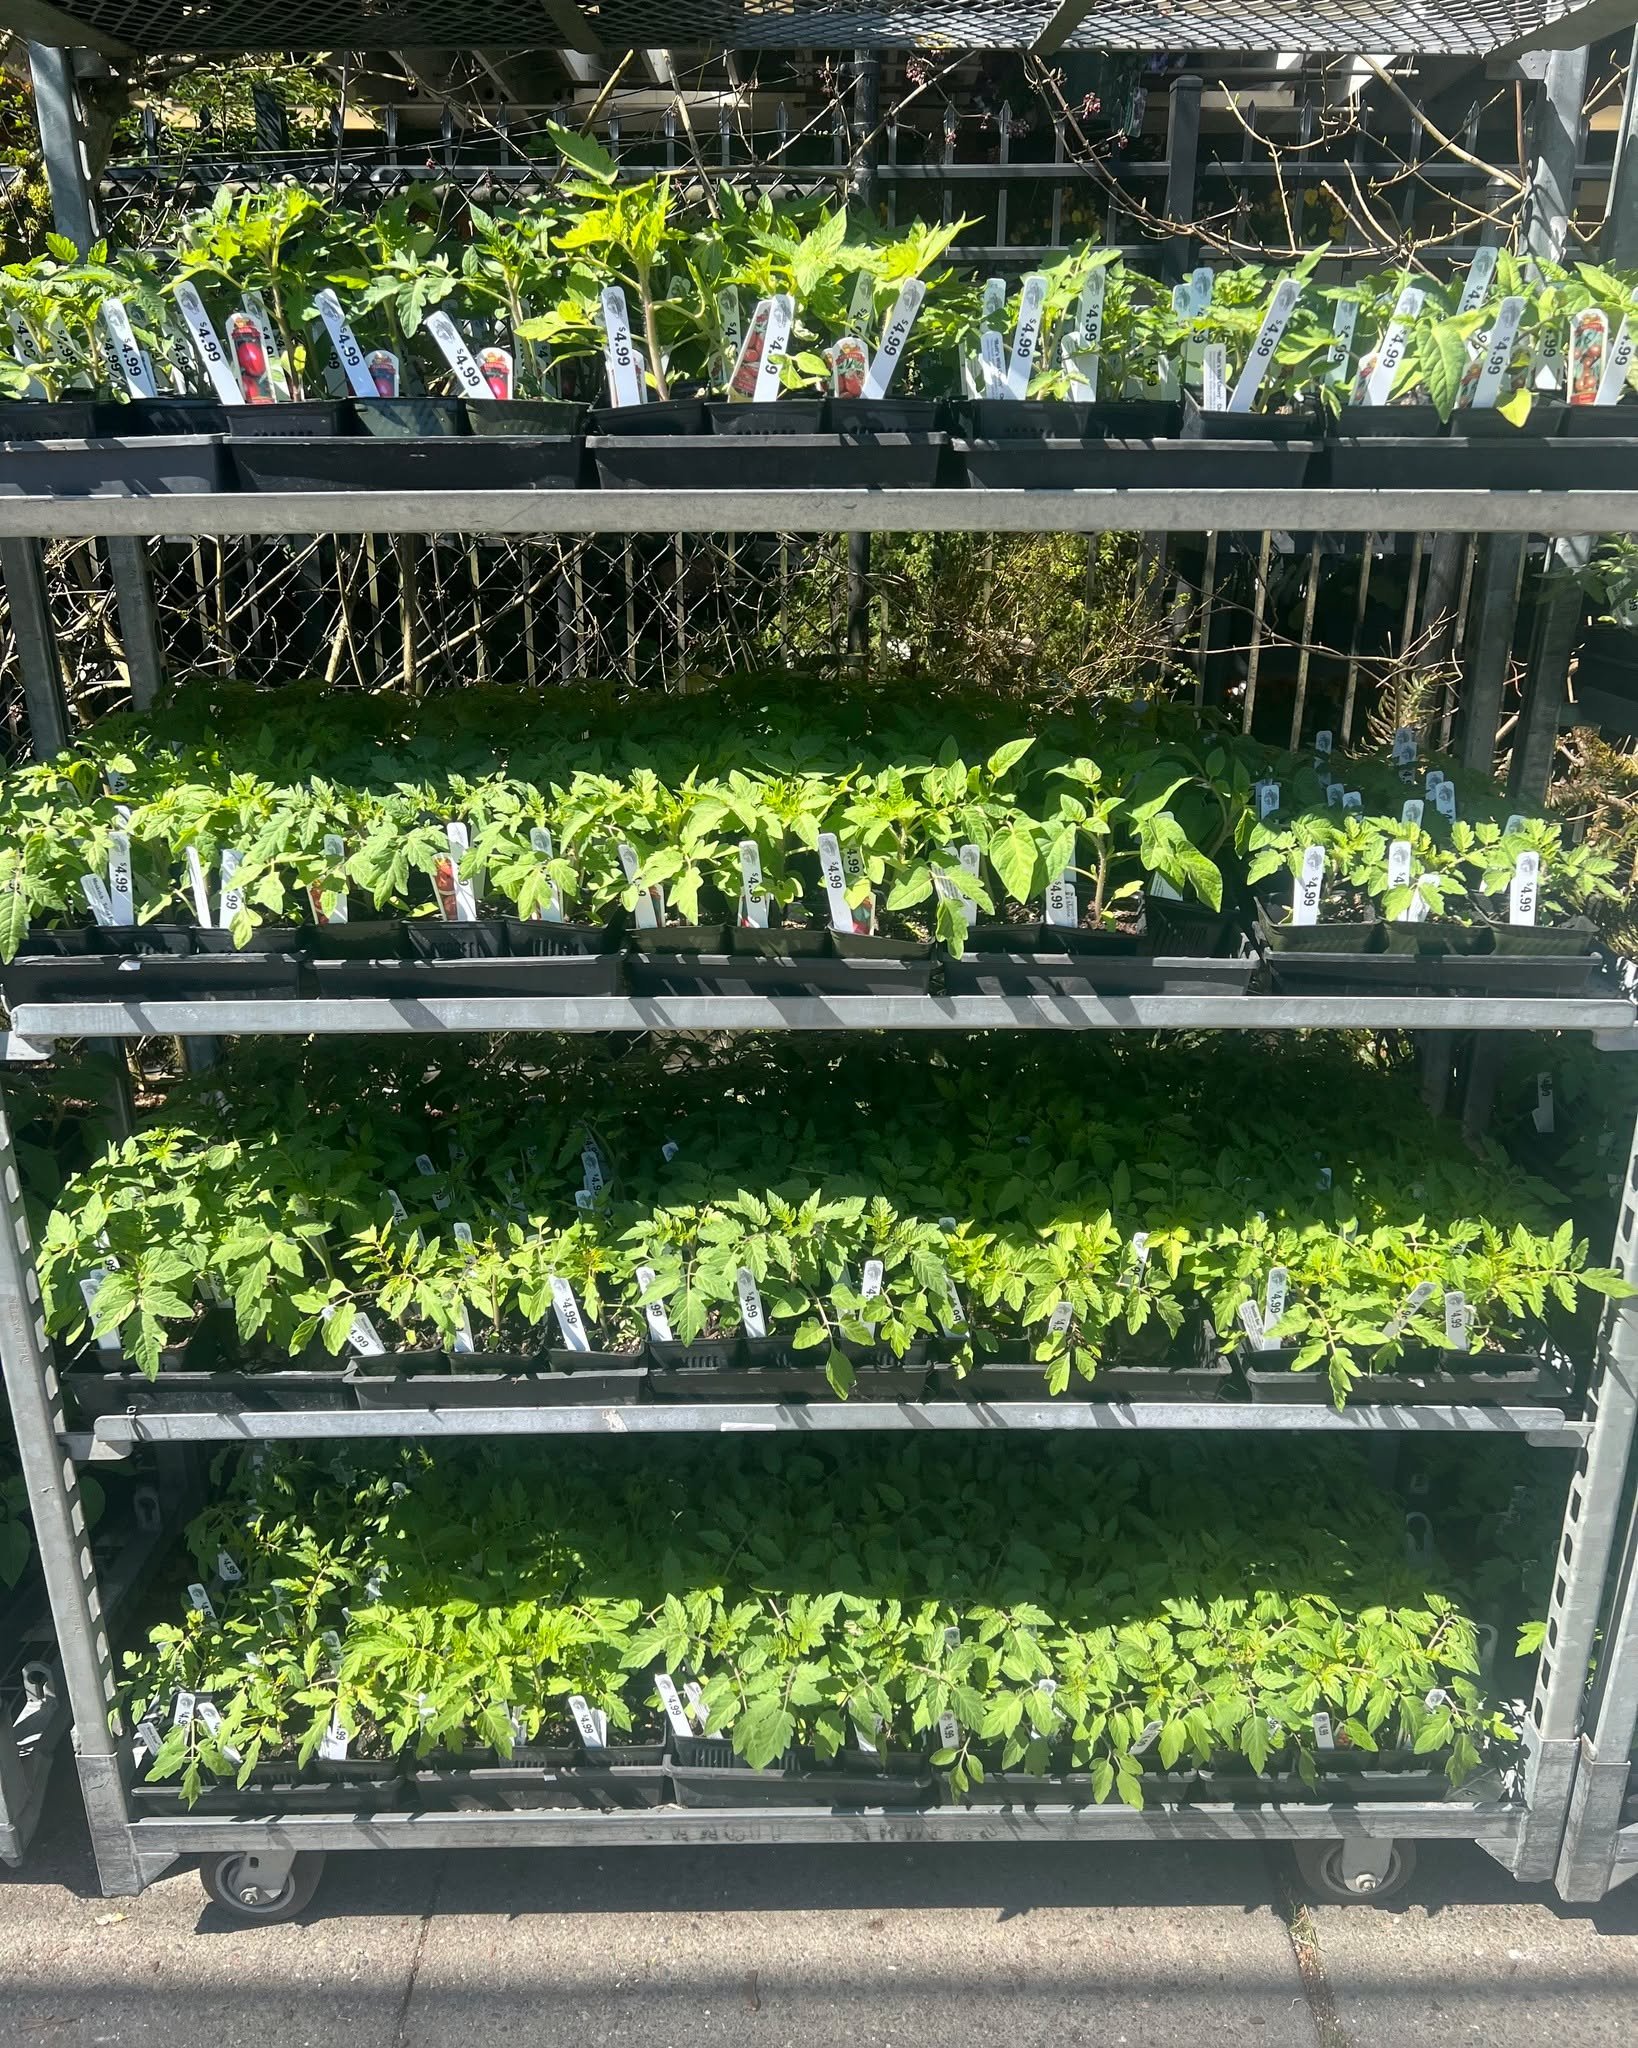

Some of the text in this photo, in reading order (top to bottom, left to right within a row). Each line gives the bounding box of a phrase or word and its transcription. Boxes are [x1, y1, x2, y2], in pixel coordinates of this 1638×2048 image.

[884, 319, 909, 356] $4.99
[1017, 318, 1037, 358] $4.99
[1085, 304, 1099, 342] $4.99
[1257, 319, 1283, 357] $4.99
[121, 338, 142, 376] $4.99
[198, 321, 221, 363] $4.99
[339, 328, 360, 366] $4.99
[614, 327, 631, 366] $4.99
[765, 336, 784, 375] $4.9
[1383, 330, 1408, 369] $4.99
[1488, 336, 1510, 374] $4.99
[456, 348, 481, 387] $4.99
[115, 862, 128, 894] $4.99
[828, 862, 843, 889] $4.99
[1304, 876, 1319, 907] $4.99
[1050, 881, 1063, 909] $4.99
[1520, 881, 1534, 912] $4.99
[562, 1298, 578, 1325] $4.99
[744, 1291, 758, 1318] $4.99
[1270, 1290, 1283, 1314] $4.99
[1451, 1308, 1463, 1329] $4.99
[668, 1696, 682, 1716] $4.99
